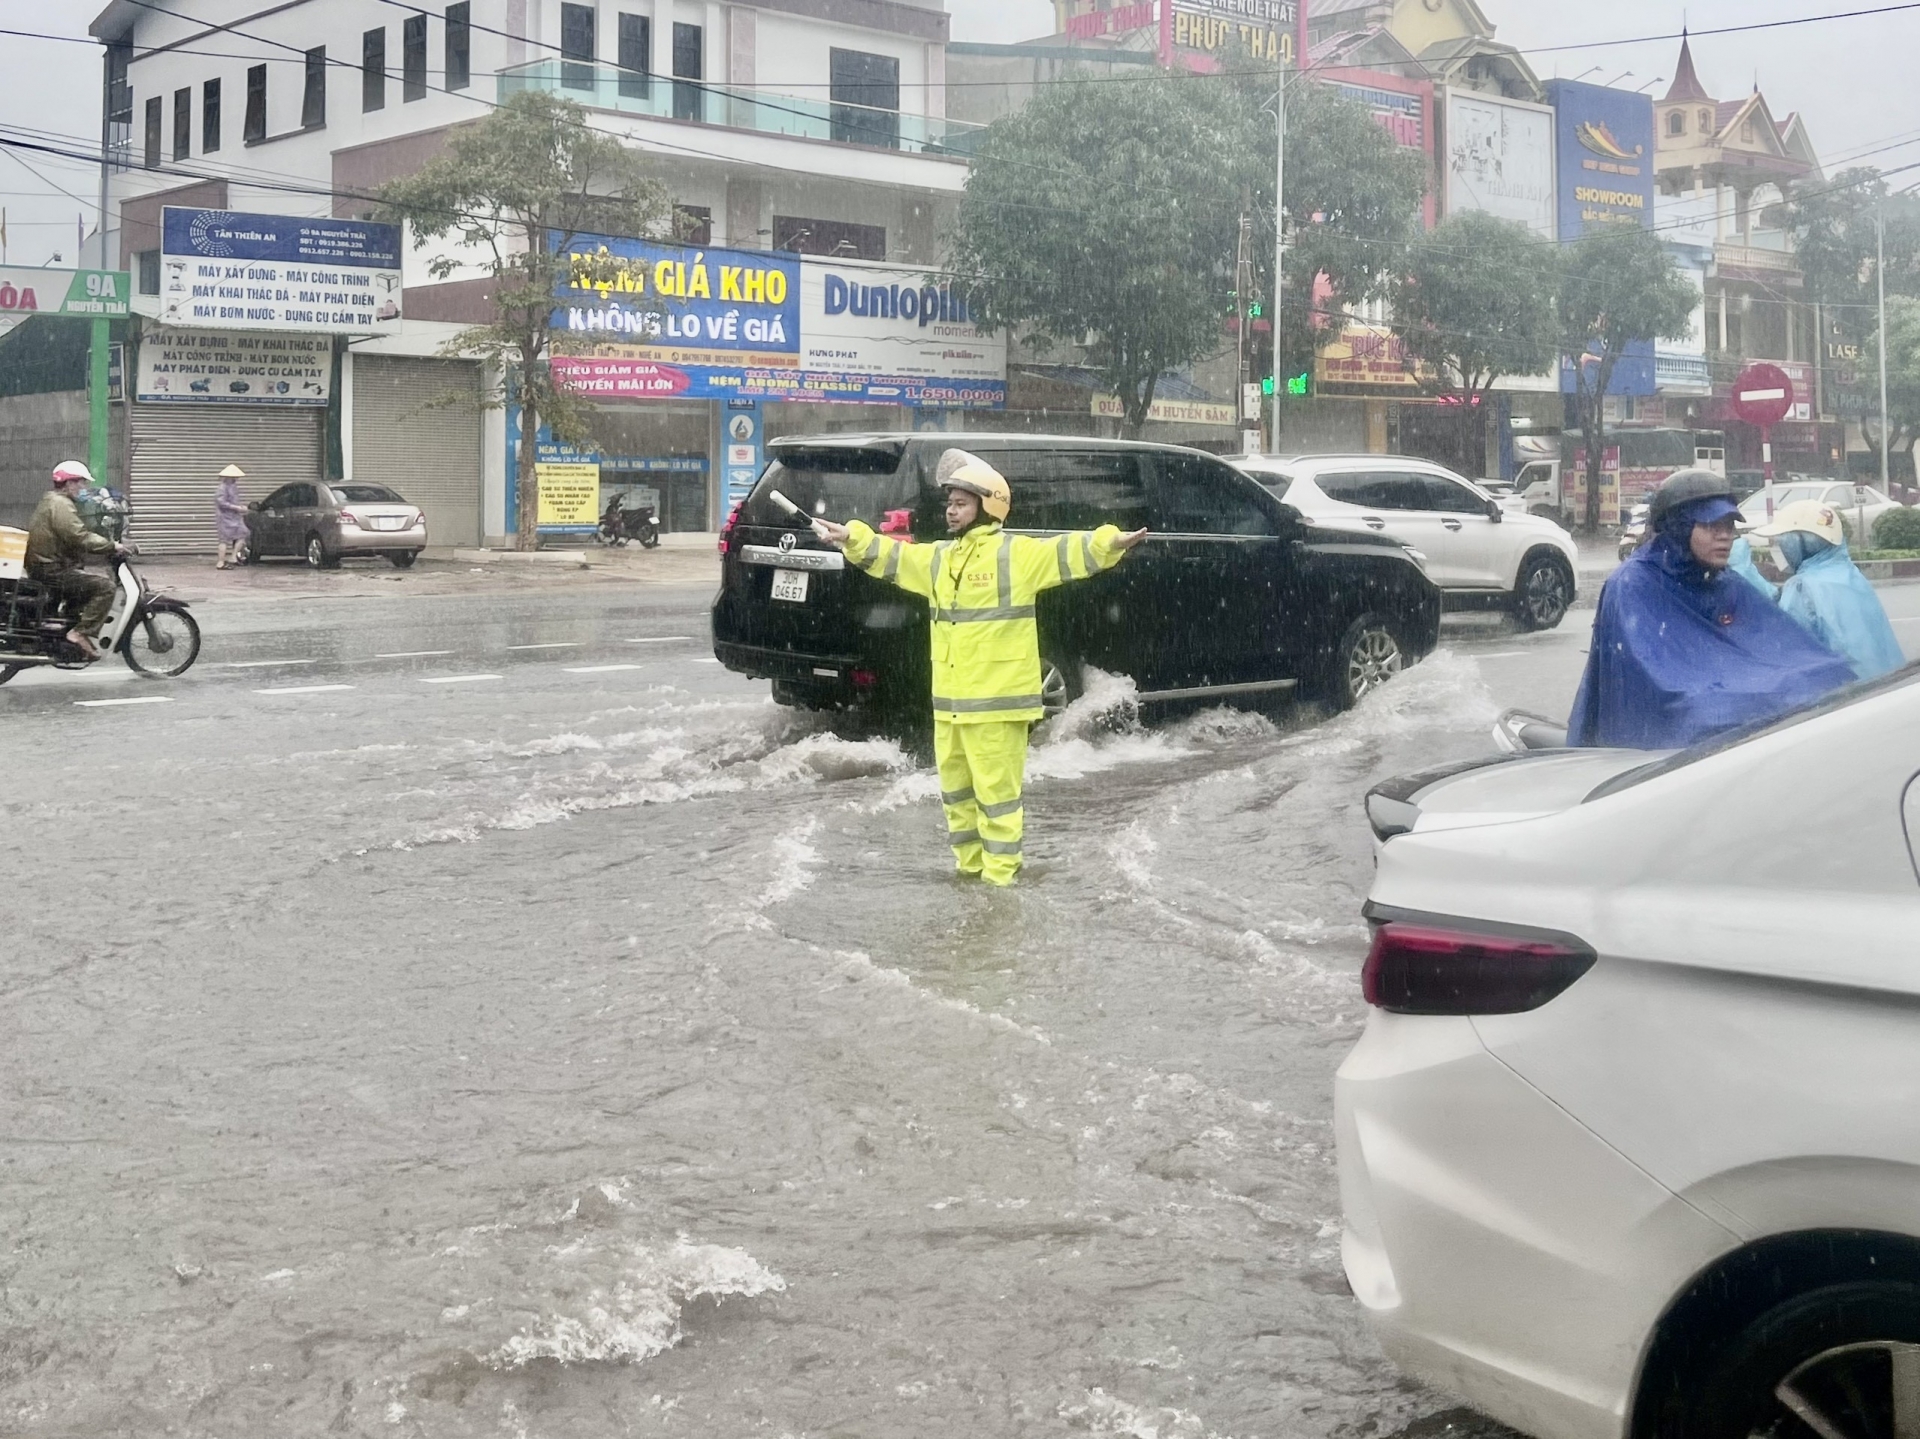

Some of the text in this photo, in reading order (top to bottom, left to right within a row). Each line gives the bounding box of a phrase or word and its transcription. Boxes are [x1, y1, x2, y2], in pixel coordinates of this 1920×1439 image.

[1575, 186, 1643, 208] SHOWROOM
[214, 228, 276, 242] TÂN THIÊN AN
[198, 264, 220, 277] MÁY
[225, 265, 245, 279] XÂY
[286, 268, 308, 282] MÁY
[312, 270, 338, 285] CÔNG
[342, 272, 370, 286] TRÌNH
[654, 252, 710, 299] GIÁ
[719, 266, 787, 304] KHO
[86, 274, 116, 298] 9A
[192, 284, 216, 297] MÁY
[219, 286, 244, 299] KHAI
[246, 287, 272, 300] THÁC
[299, 290, 322, 303] MÁY
[325, 291, 350, 304] PHÁT
[66, 298, 126, 314] NGUYỄN TRÃI
[194, 304, 217, 318] MÁY
[220, 306, 244, 320] BƠM
[247, 306, 275, 320] NƯỚC
[316, 310, 329, 324] CỤ
[357, 313, 373, 326] TAY
[569, 302, 786, 343] KHÔNG LO VỀ GIÁ
[263, 340, 286, 350] KHAI
[809, 349, 834, 358] HƯNG
[304, 368, 323, 378] TAY
[708, 376, 741, 386] NỆM
[803, 381, 862, 392] CLASSIC
[1204, 407, 1228, 421] SÂM
